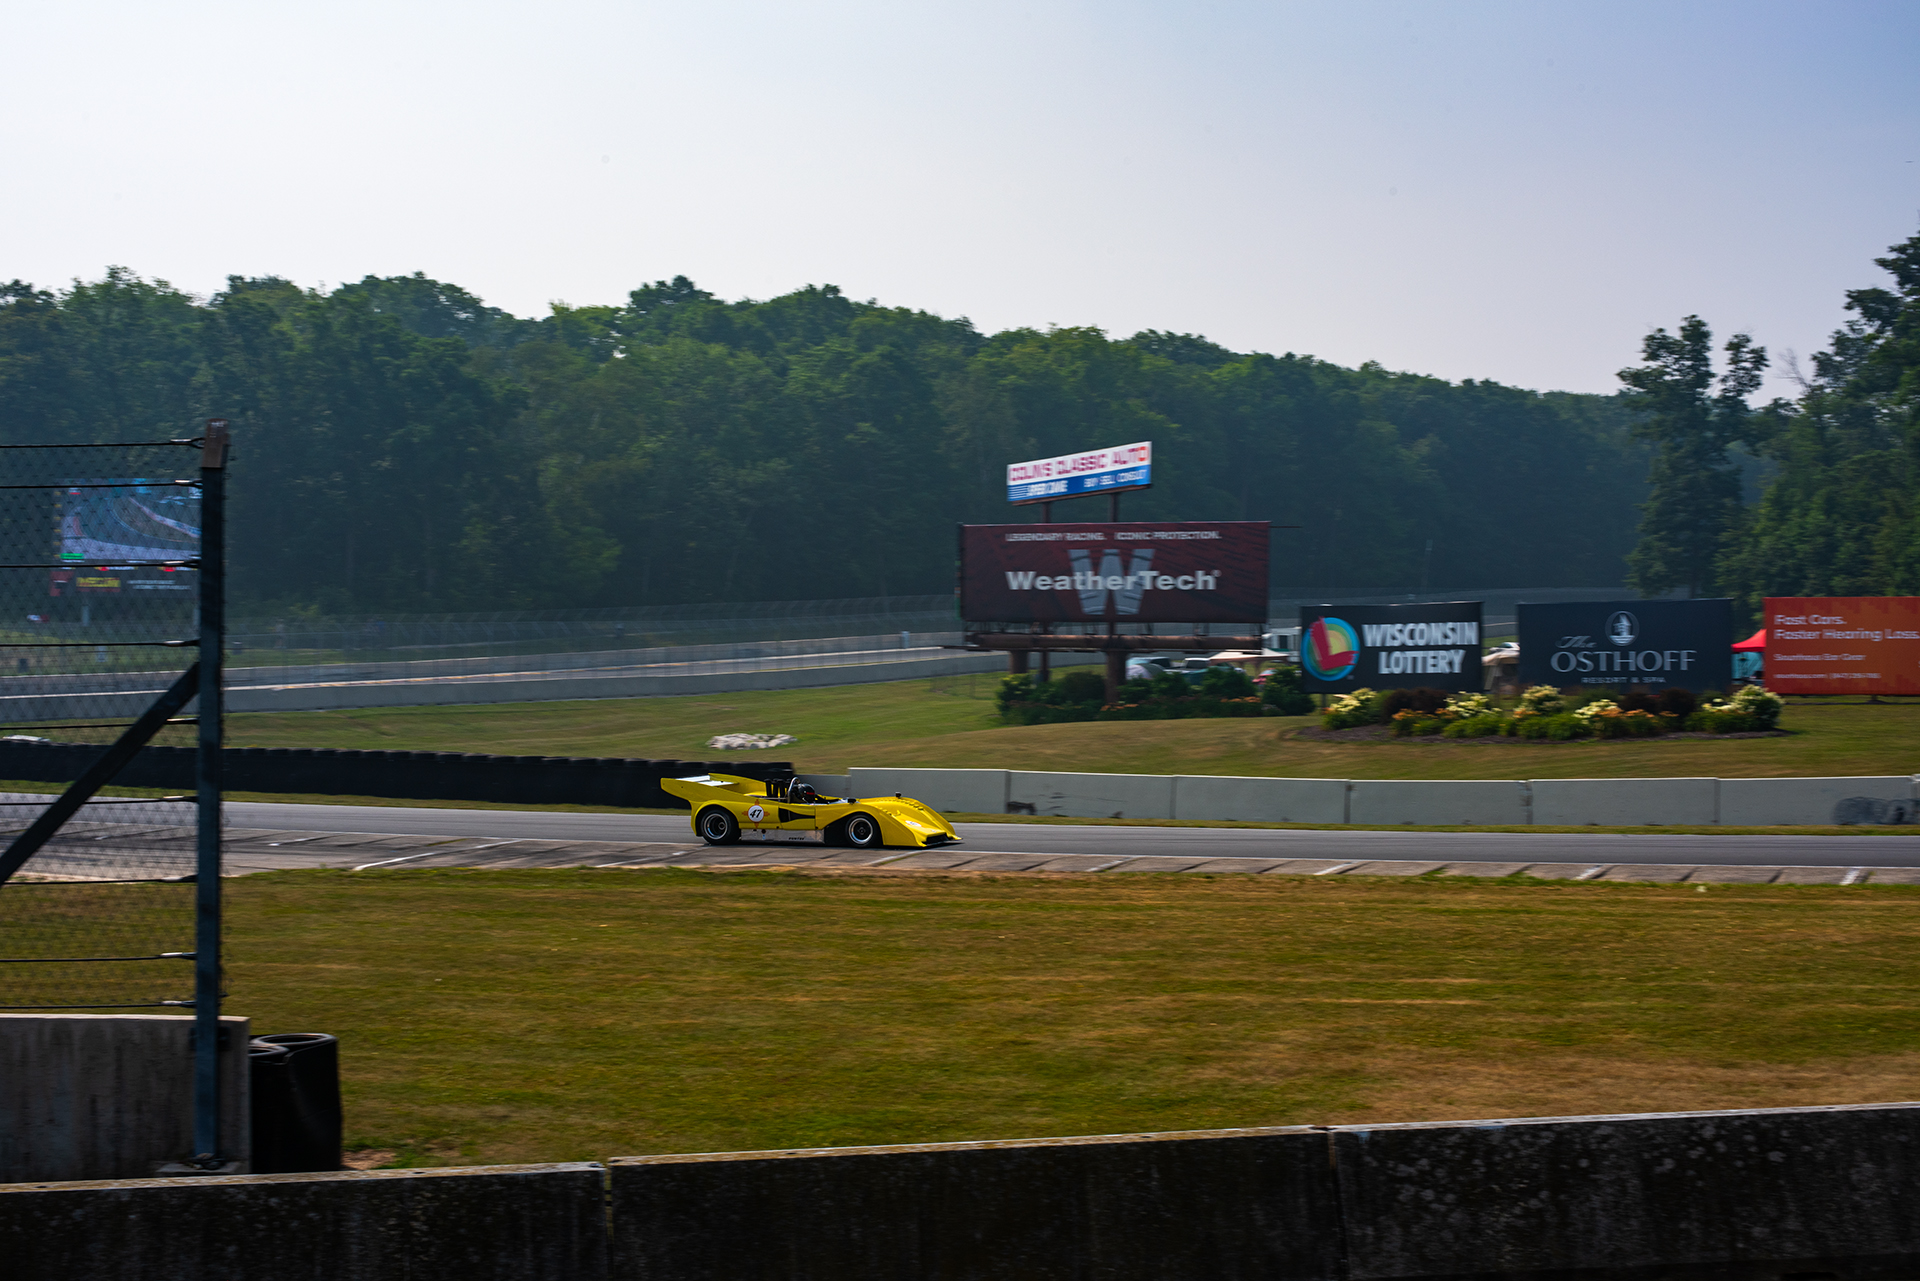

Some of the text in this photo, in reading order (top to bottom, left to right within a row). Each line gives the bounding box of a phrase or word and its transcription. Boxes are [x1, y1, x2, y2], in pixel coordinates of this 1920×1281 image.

[1055, 453, 1107, 475] CLASSIC
[1111, 446, 1147, 466] AUTO
[1005, 532, 1063, 542] LEGENDARY
[1113, 531, 1153, 541] ICONIC
[1153, 530, 1223, 540] PROTECTION.
[1773, 614, 1848, 625] Fast Cars.
[1361, 621, 1479, 647] WISCONSIN
[1773, 629, 1822, 640] Faster
[1822, 627, 1883, 642] Hearing
[1554, 635, 1597, 649] The
[1378, 649, 1466, 675] LOTTERY
[1550, 650, 1697, 673] OSTHOFF
[750, 809, 762, 818] 47
